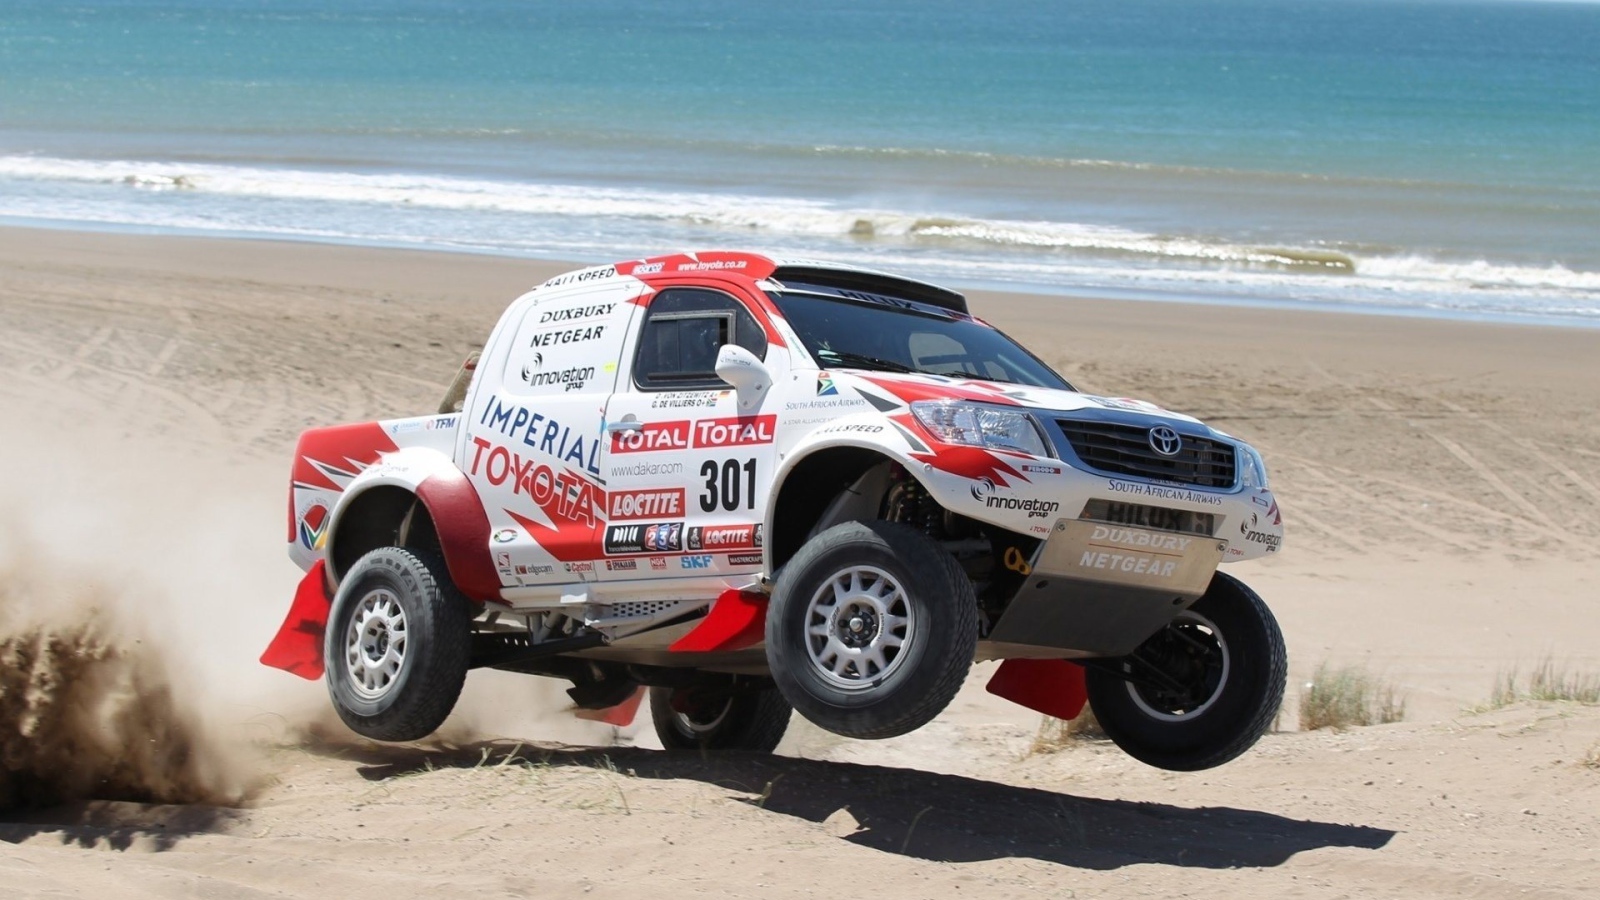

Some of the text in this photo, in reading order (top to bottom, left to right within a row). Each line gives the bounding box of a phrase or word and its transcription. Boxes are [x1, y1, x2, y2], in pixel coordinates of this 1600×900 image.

[539, 303, 617, 323] DUXBURY
[530, 326, 604, 348] NETGEAR
[530, 366, 595, 387] innovation
[565, 381, 584, 392] group
[659, 400, 668, 408] DE
[669, 399, 696, 408] VILLIERS
[809, 400, 837, 409] AFRICAN
[838, 398, 866, 407] AIRWAYS
[435, 417, 456, 429] TFM
[480, 395, 600, 475] IMPERIAL
[697, 420, 772, 445] TOTAL
[611, 461, 683, 477] www.dakar.com
[470, 436, 596, 530] TOYOTA
[699, 457, 757, 513] 301
[1108, 479, 1143, 494] SOUTH
[1144, 485, 1187, 501] AFRICAN
[1184, 491, 1222, 506] AIRWAYS
[611, 491, 681, 517] LOCTITE
[986, 496, 1059, 512] innovation
[704, 529, 750, 545] LOCTITE
[1033, 526, 1047, 534] TOW
[1090, 526, 1192, 551] DUXBURY
[527, 564, 553, 575] edgecam
[571, 562, 592, 572] Castrol
[681, 555, 713, 568] SKF
[1079, 551, 1176, 577] NETGEAR
